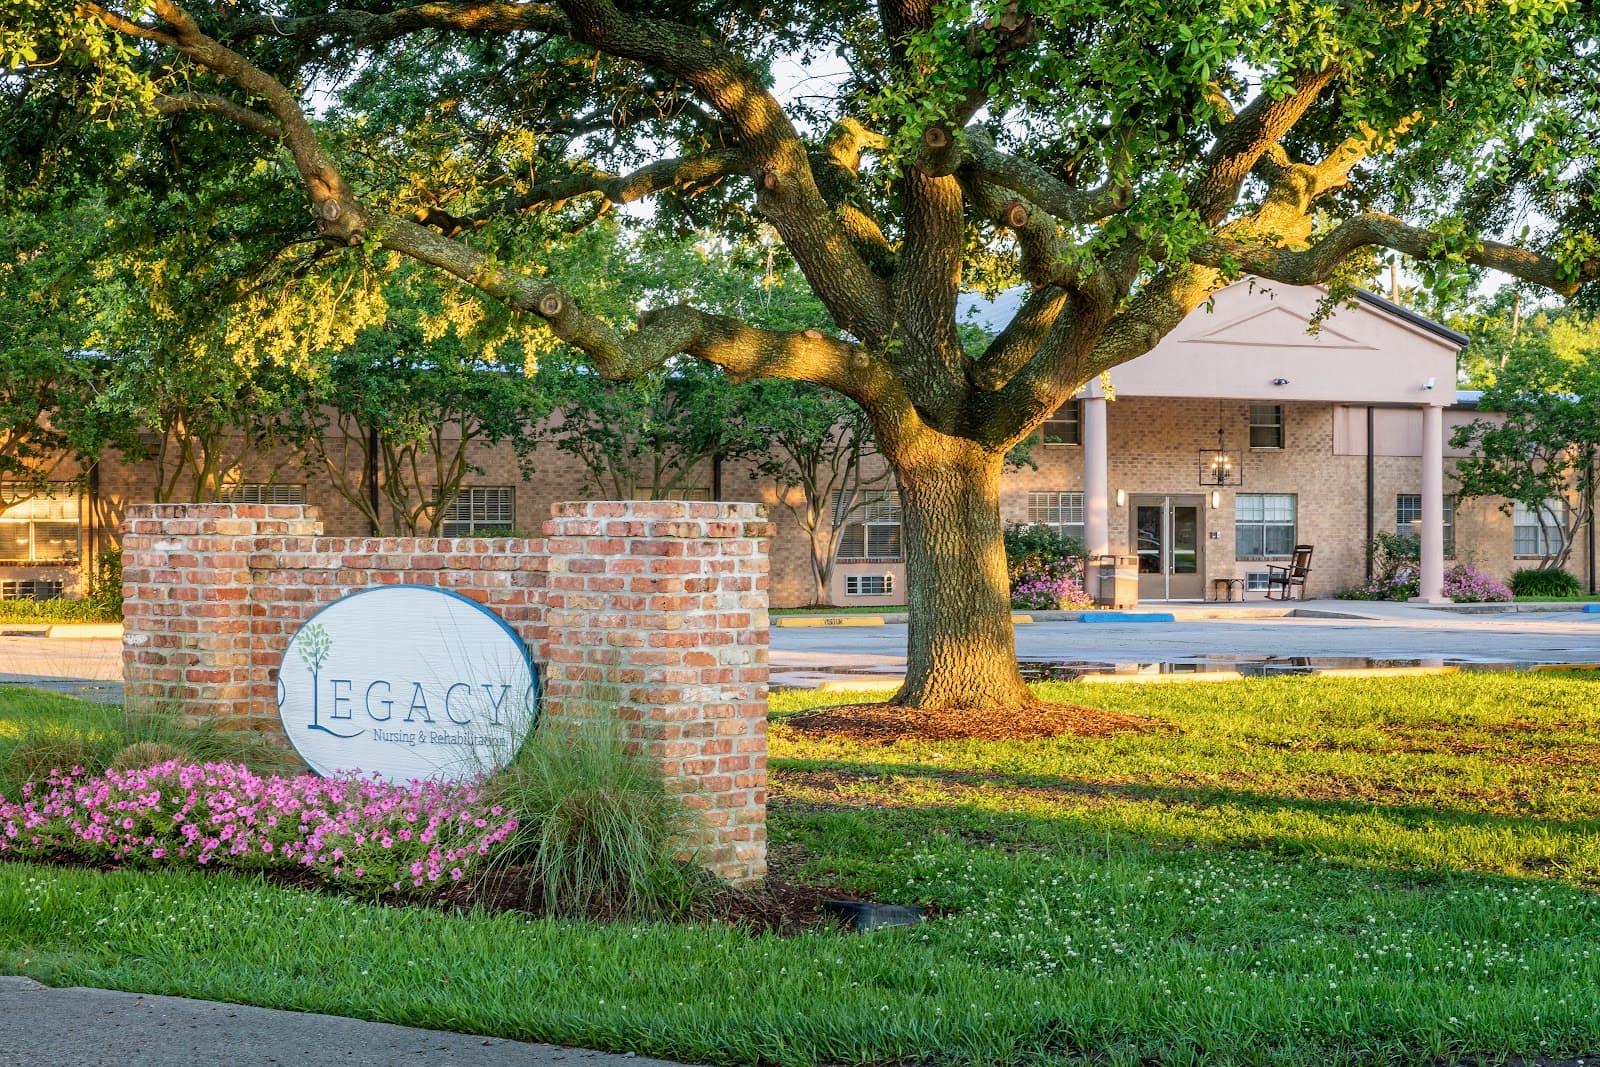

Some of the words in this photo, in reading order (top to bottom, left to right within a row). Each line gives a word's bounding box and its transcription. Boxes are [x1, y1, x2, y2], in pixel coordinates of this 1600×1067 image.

[307, 673, 512, 731] LEGACY
[374, 729, 416, 747] Nursing
[418, 730, 427, 743] &
